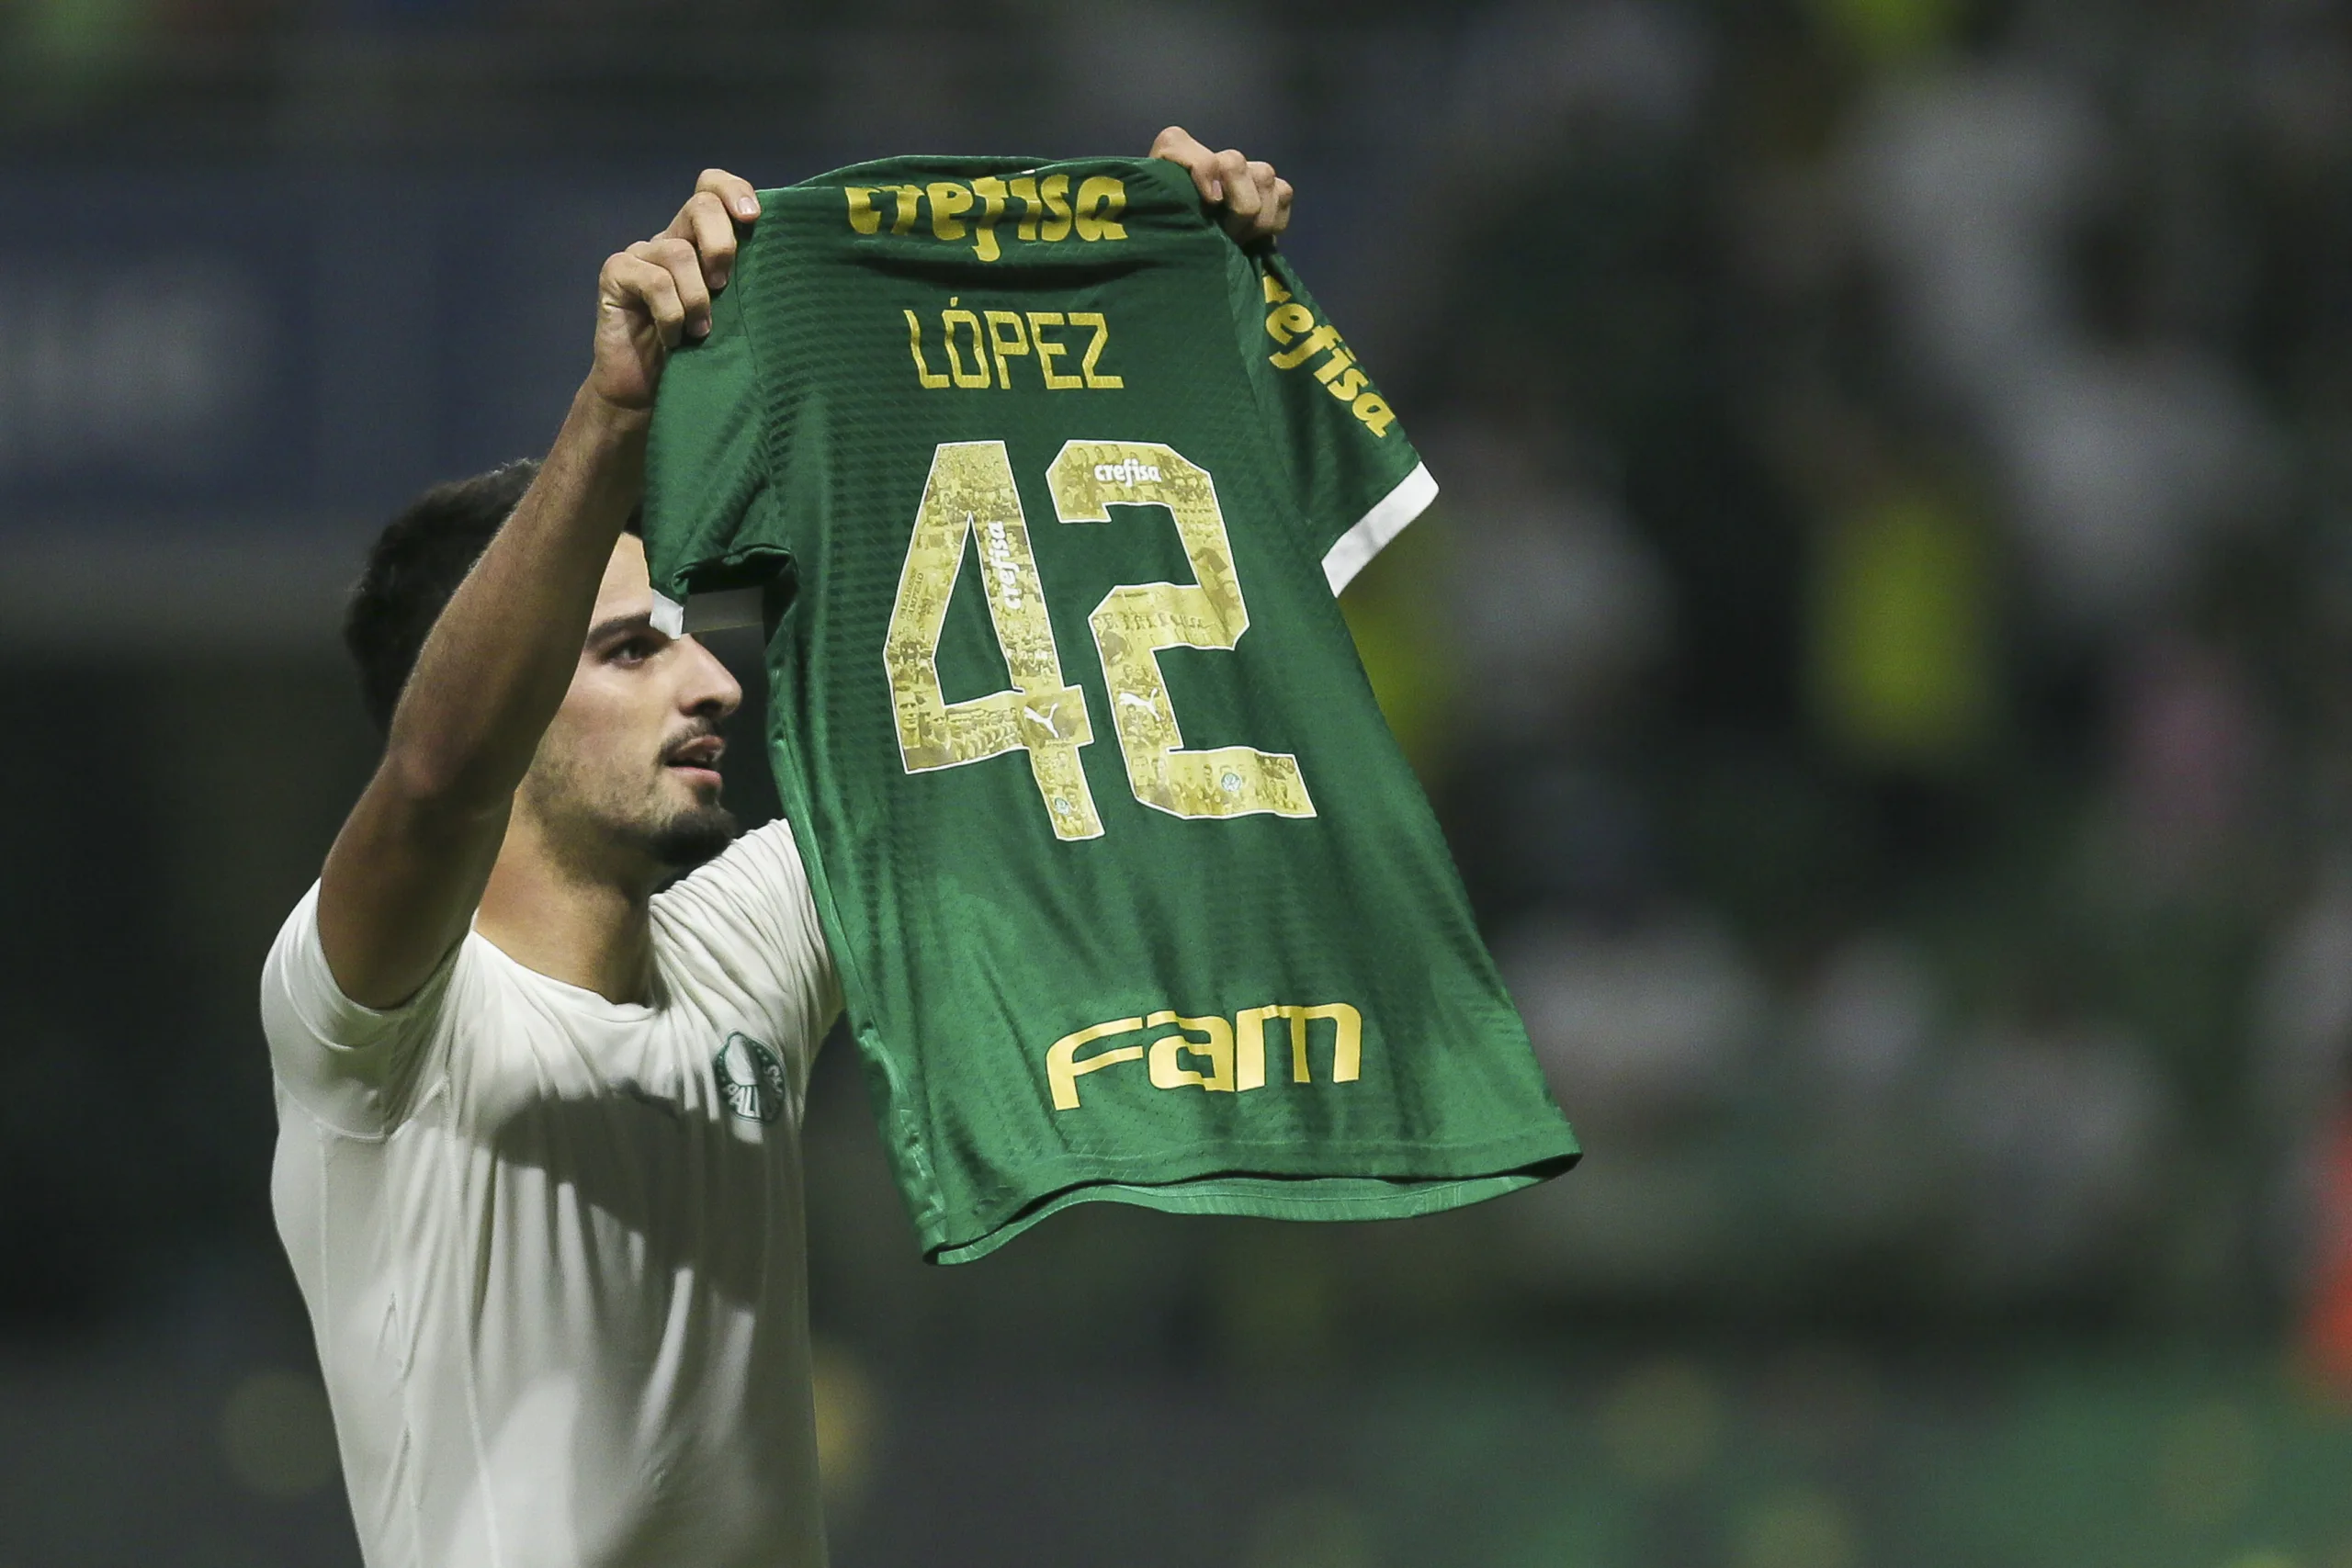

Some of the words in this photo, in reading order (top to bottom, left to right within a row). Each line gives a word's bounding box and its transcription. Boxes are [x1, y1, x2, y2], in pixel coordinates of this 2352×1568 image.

[844, 175, 1128, 262] crefisa
[903, 297, 1124, 389] LÓPEZ
[1262, 270, 1396, 438] refisa
[1093, 458, 1162, 488] crefisa
[988, 521, 1022, 610] crefisa
[883, 439, 1317, 841] 42
